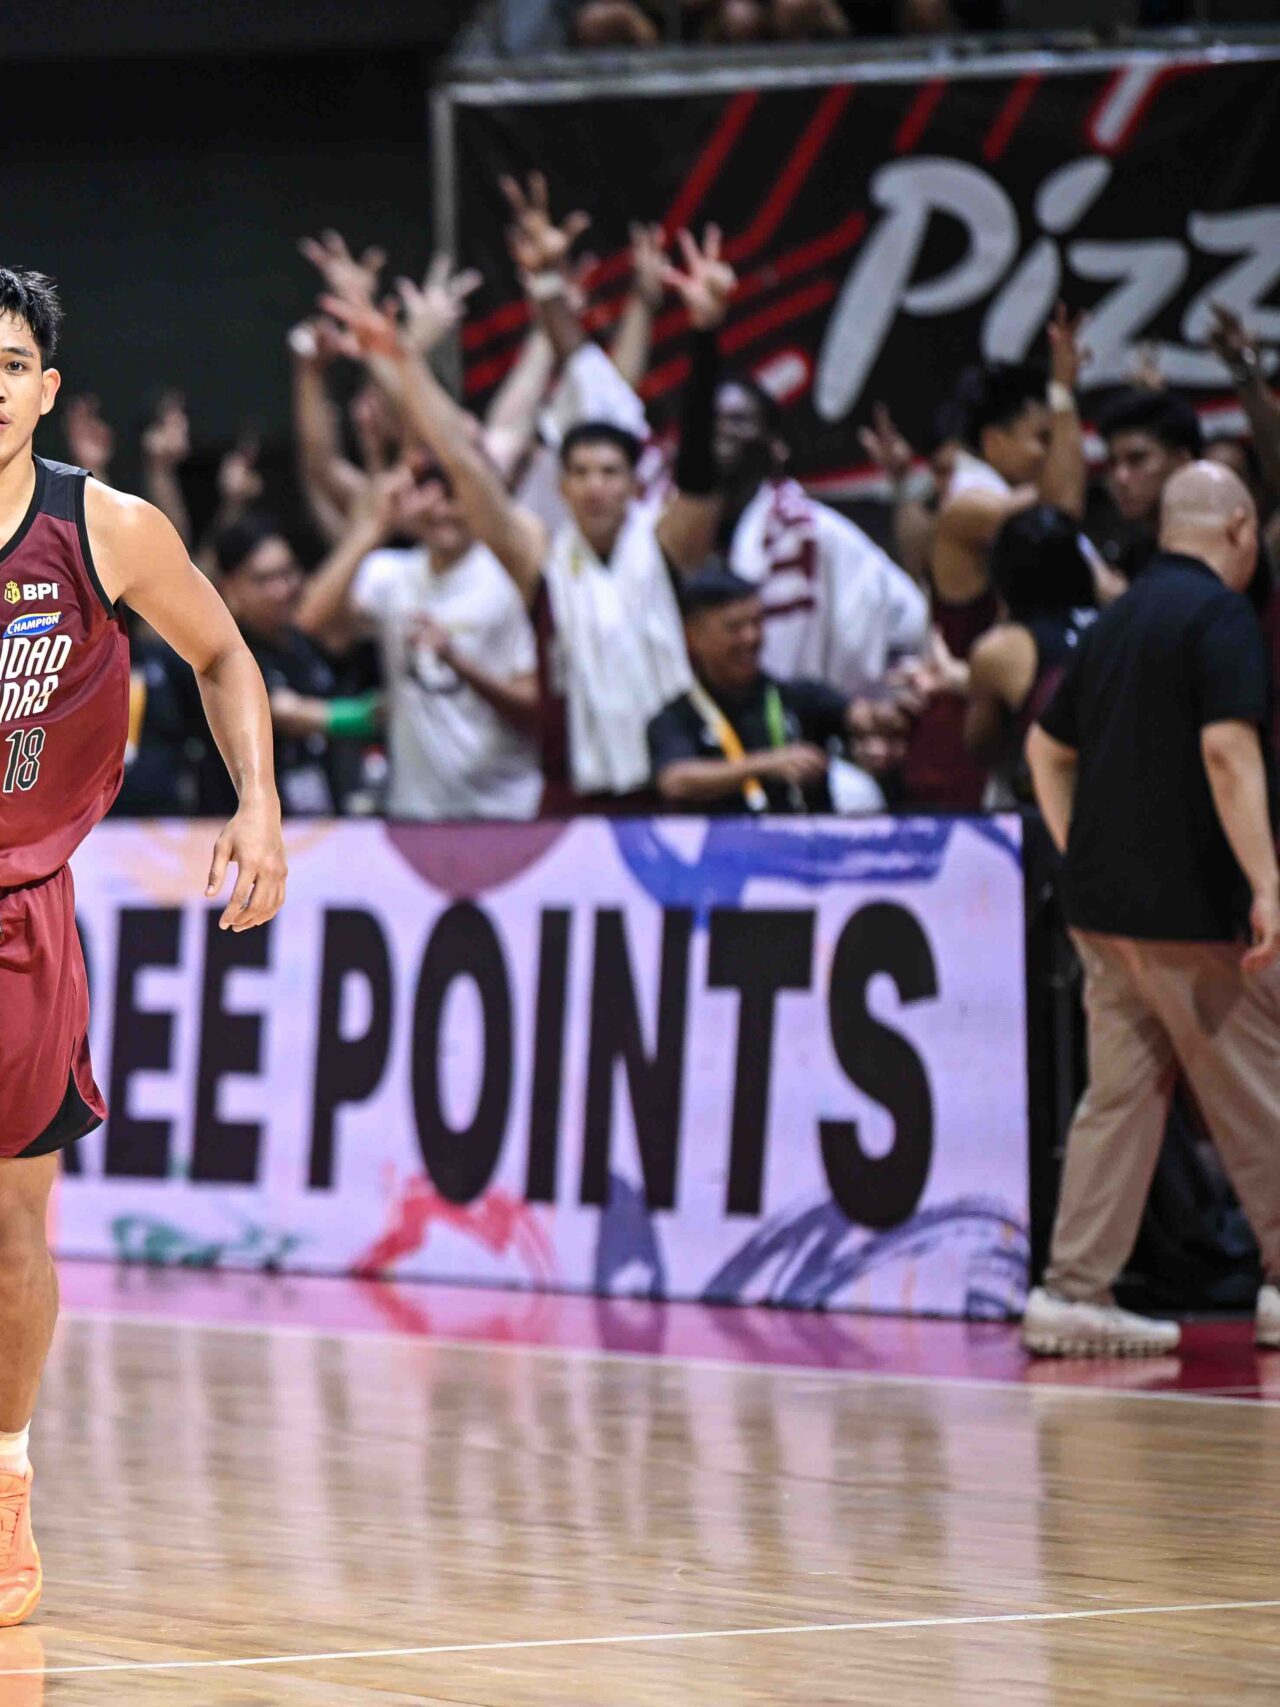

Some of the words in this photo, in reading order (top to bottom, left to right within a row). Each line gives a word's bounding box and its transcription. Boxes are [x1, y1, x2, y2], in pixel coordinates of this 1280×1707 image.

[22, 582, 59, 600] BPI
[7, 614, 60, 635] CHAMPION
[2, 727, 46, 793] 18
[306, 898, 940, 1230] POINTS
